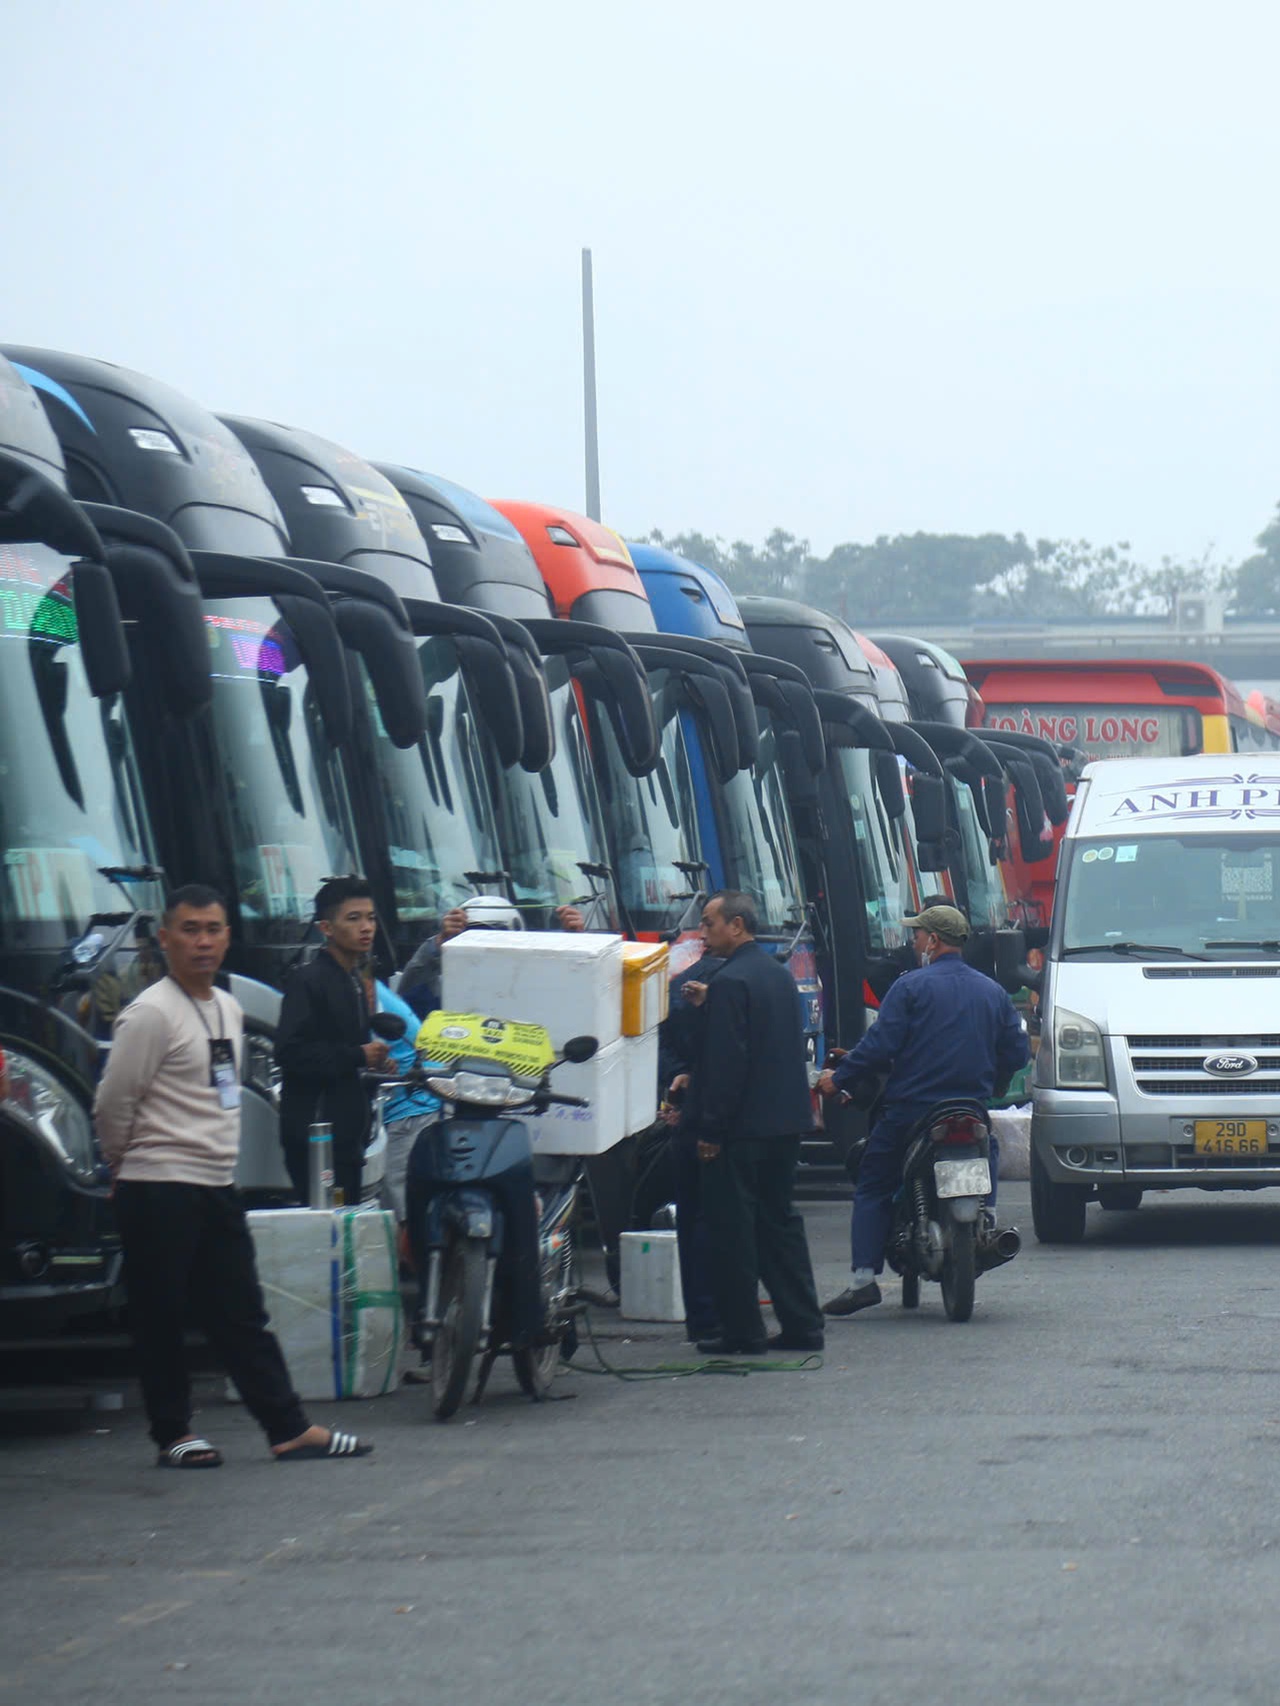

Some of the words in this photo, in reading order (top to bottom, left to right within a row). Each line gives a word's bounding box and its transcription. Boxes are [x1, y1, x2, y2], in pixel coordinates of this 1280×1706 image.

[1085, 715, 1160, 743] LONG
[1111, 789, 1219, 817] ANH
[1216, 1057, 1244, 1069] Ford
[1215, 1122, 1246, 1137] 29D
[1202, 1138, 1260, 1153] 416.66
